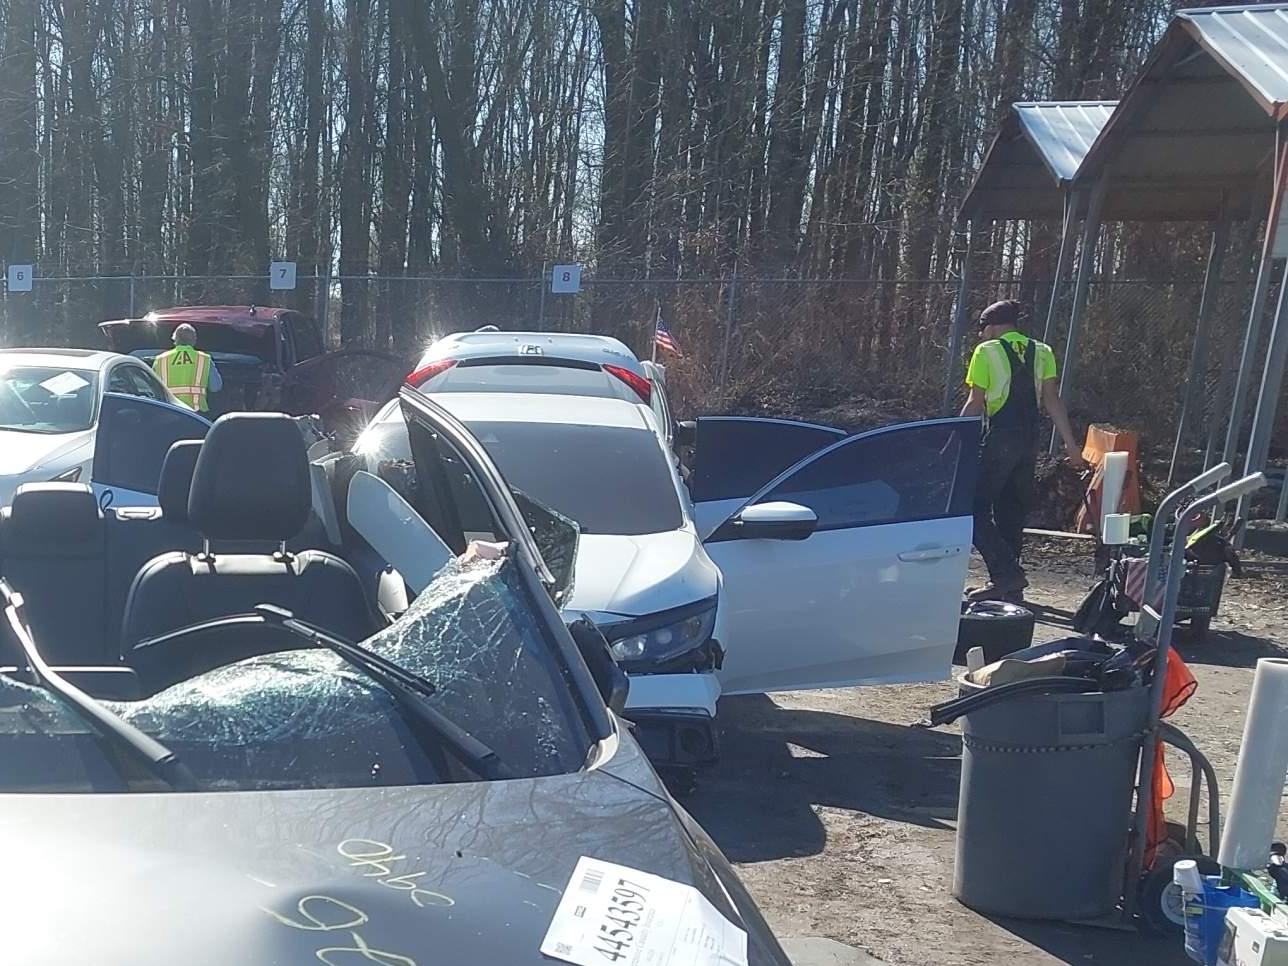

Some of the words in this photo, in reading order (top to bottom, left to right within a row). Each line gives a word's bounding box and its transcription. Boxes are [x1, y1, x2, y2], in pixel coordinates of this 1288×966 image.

[16, 271, 24, 281] 6
[279, 268, 287, 279] 7
[562, 271, 571, 282] 8
[593, 878, 651, 962] 44543597
